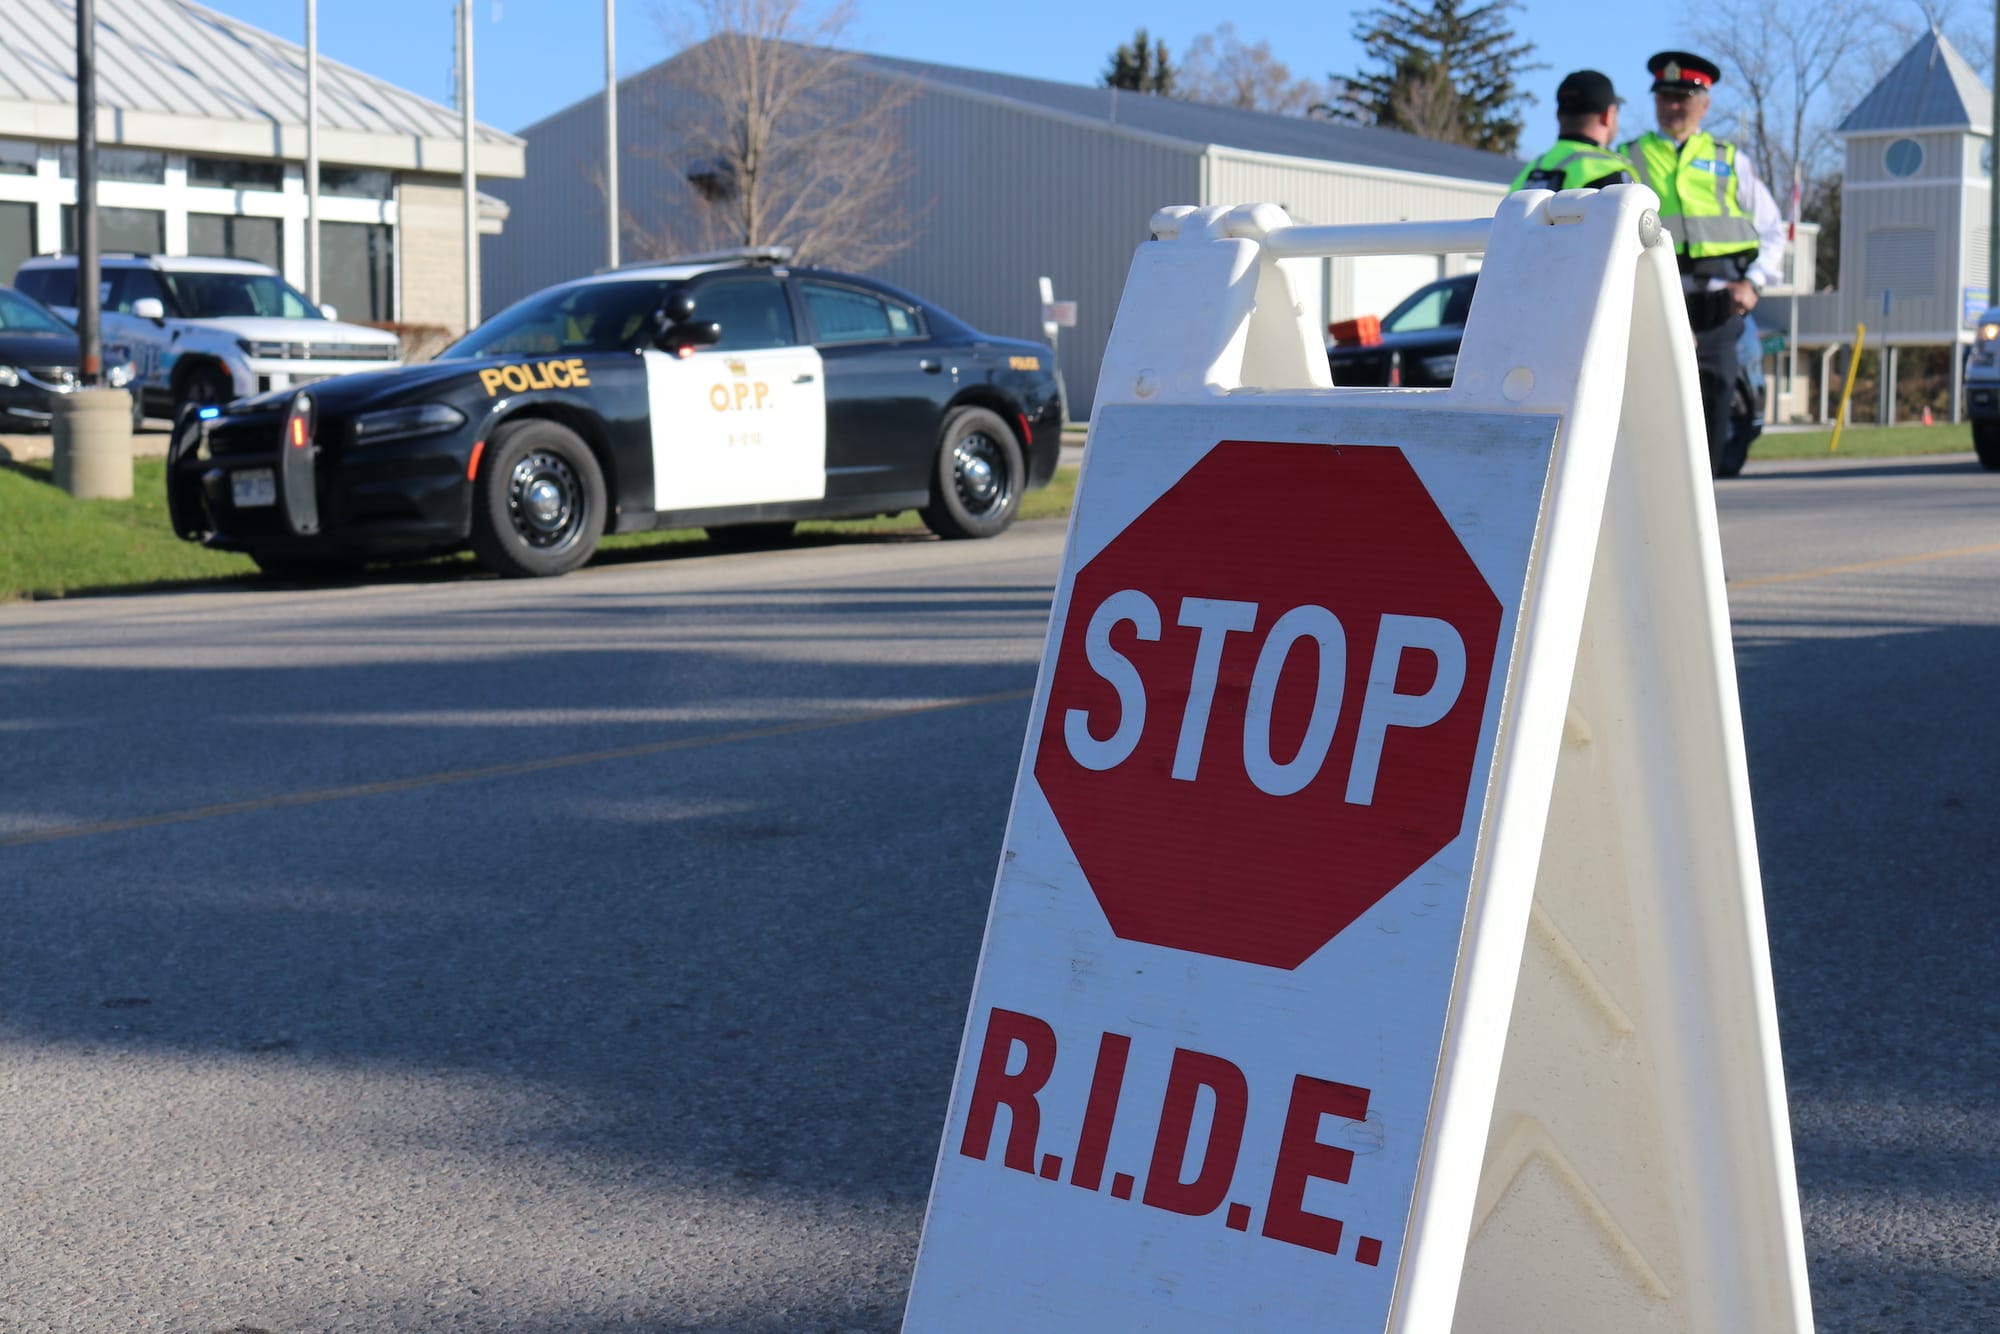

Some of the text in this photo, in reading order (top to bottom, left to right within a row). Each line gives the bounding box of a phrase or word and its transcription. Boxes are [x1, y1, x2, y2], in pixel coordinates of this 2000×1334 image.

[479, 359, 591, 397] POLICE
[1064, 590, 1467, 806] STOP
[960, 1008, 1382, 1267] R.I.D.E.
